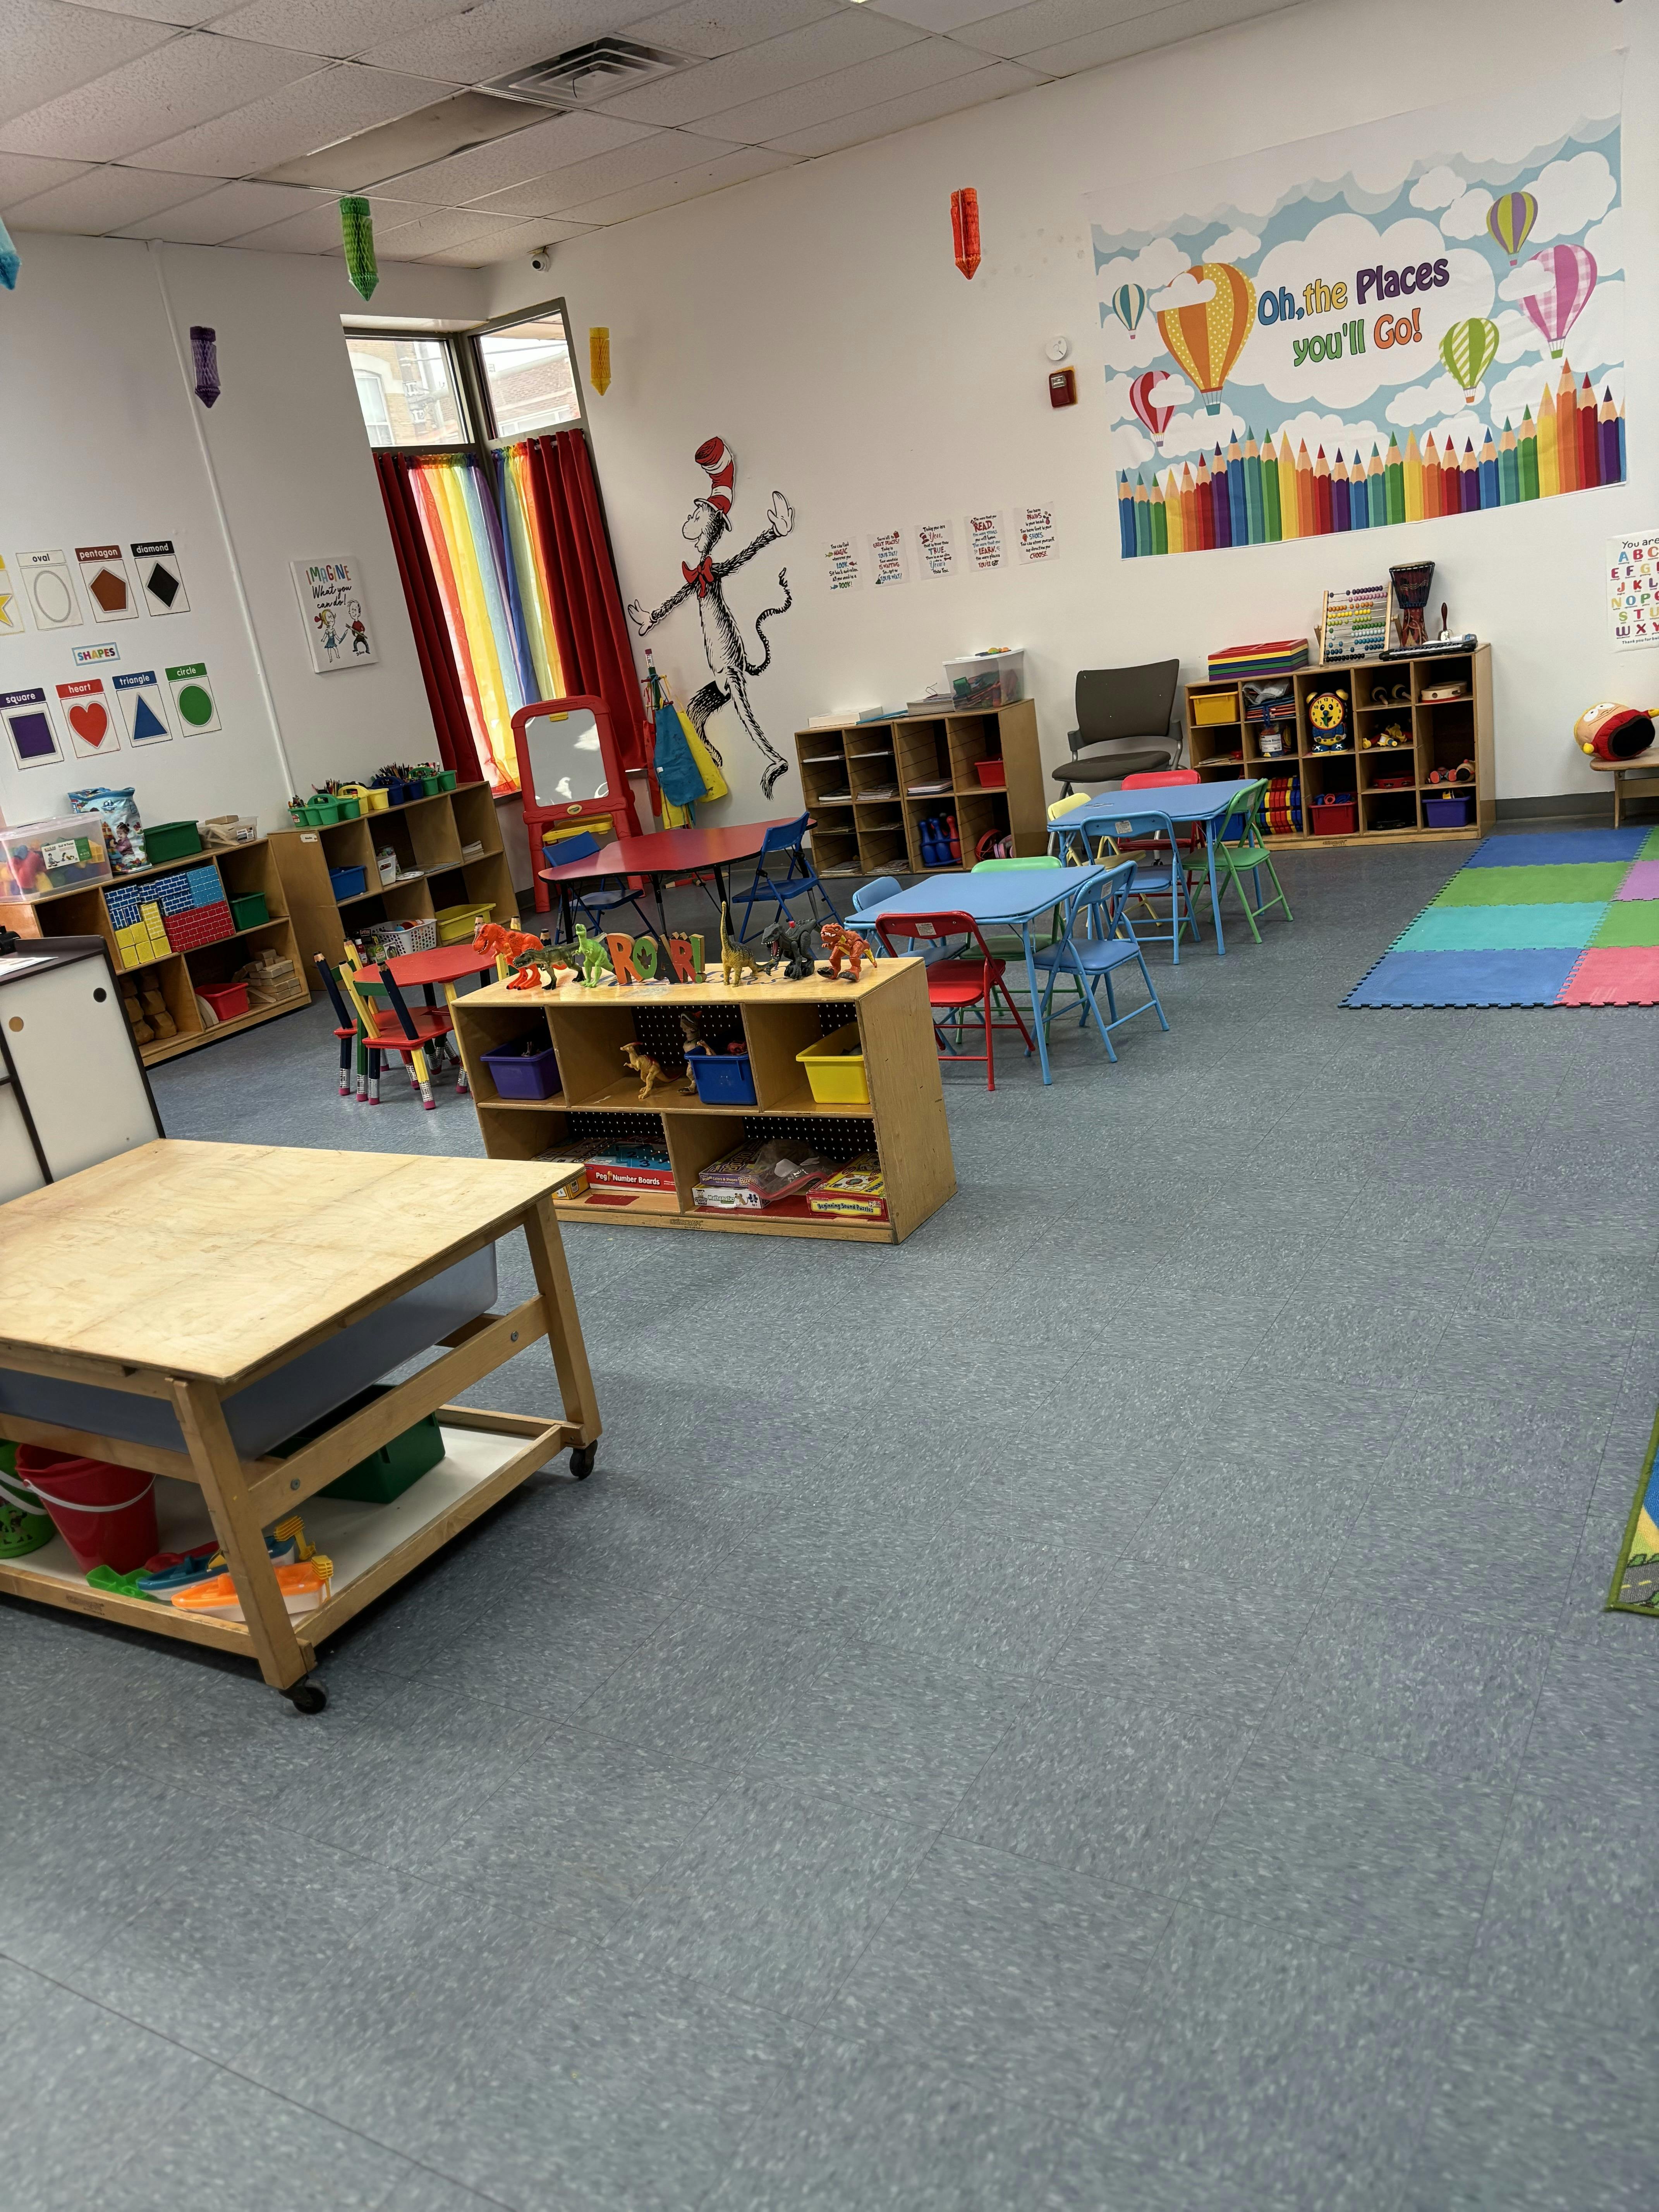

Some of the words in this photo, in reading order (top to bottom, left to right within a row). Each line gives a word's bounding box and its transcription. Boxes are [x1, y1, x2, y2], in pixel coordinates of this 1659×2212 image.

[1356, 258, 1450, 305] Places
[1293, 319, 1366, 367] you'll
[1374, 307, 1422, 349] Go!
[974, 520, 994, 532] READ,
[79, 548, 118, 559] pentagon
[136, 543, 169, 553] diamond
[929, 546, 946, 555] TRUE.
[1619, 551, 1629, 562] A
[1633, 549, 1643, 560] B
[1648, 546, 1659, 557] C
[33, 554, 50, 562] oval
[306, 564, 351, 585] IMAGINE
[1611, 568, 1619, 578] E
[1626, 565, 1634, 576] F
[1640, 563, 1650, 574] G
[312, 583, 336, 599] What
[338, 586, 352, 599] you
[1617, 582, 1625, 592] J
[1633, 580, 1642, 590] K
[1649, 578, 1658, 588] L
[334, 594, 346, 606] do!
[1611, 597, 1621, 608] N
[1626, 596, 1636, 606] O
[1641, 593, 1650, 604] P
[1619, 611, 1628, 622] S
[1633, 608, 1644, 619] T
[1616, 626, 1630, 637] W
[1636, 623, 1646, 634] X
[77, 647, 115, 661] SHAPES
[177, 667, 196, 676] circle
[119, 675, 149, 685] triangle
[68, 684, 91, 693] heart
[5, 692, 36, 704] square
[606, 932, 707, 984] ROAR!
[596, 1172, 607, 1181] Peg
[612, 1174, 637, 1183] Number
[638, 1176, 660, 1185] Boards
[817, 1203, 840, 1211] Beginning
